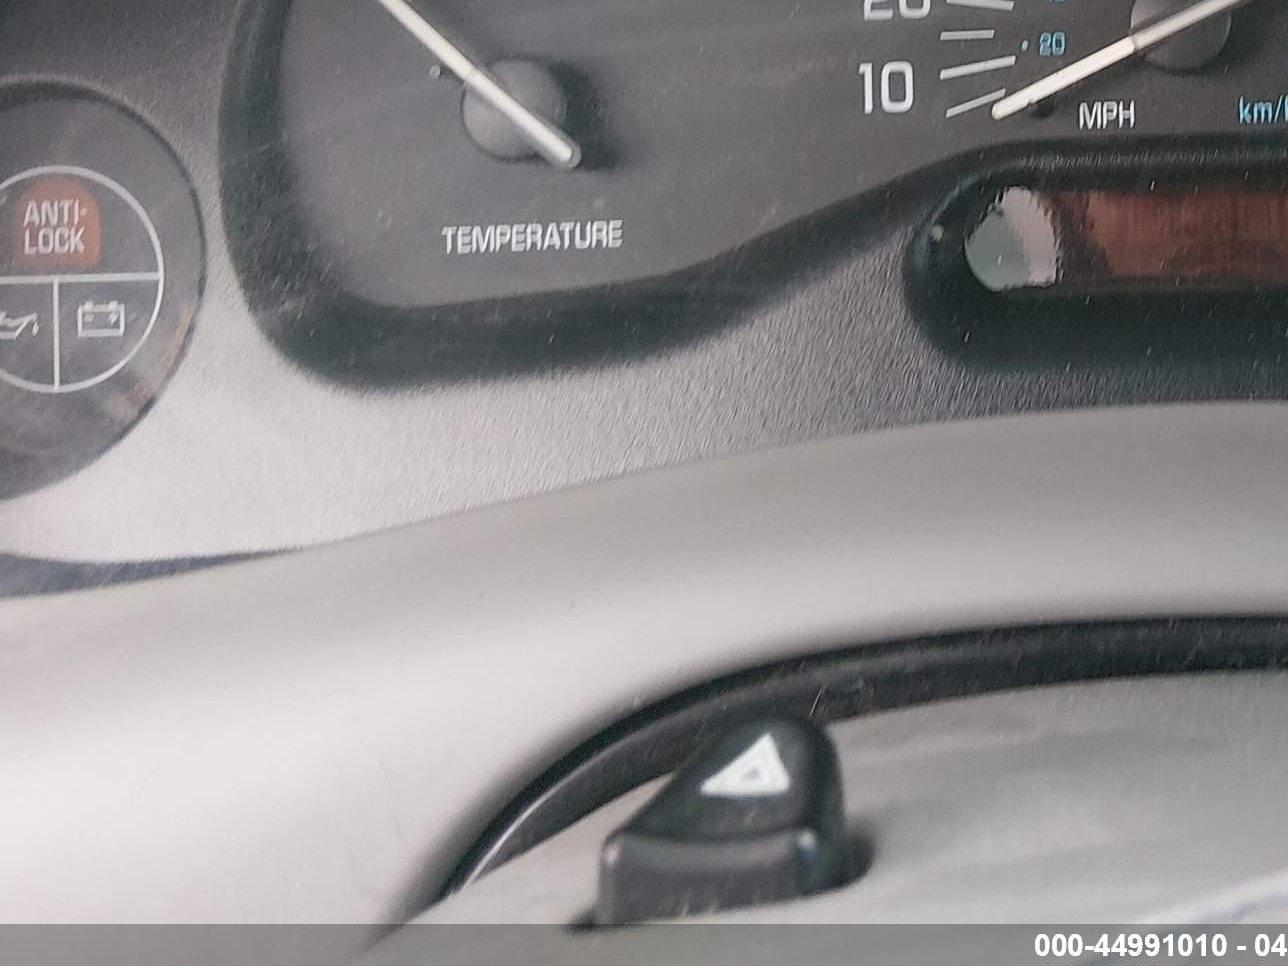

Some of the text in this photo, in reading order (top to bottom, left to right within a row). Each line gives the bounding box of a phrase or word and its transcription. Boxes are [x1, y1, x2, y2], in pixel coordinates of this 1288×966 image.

[1039, 31, 1066, 56] 20
[858, 60, 914, 115] 10
[1078, 100, 1136, 131] MPH
[23, 198, 89, 227] ANTI-
[23, 226, 86, 255] LOCK
[441, 219, 624, 255] TEMPERATURE
